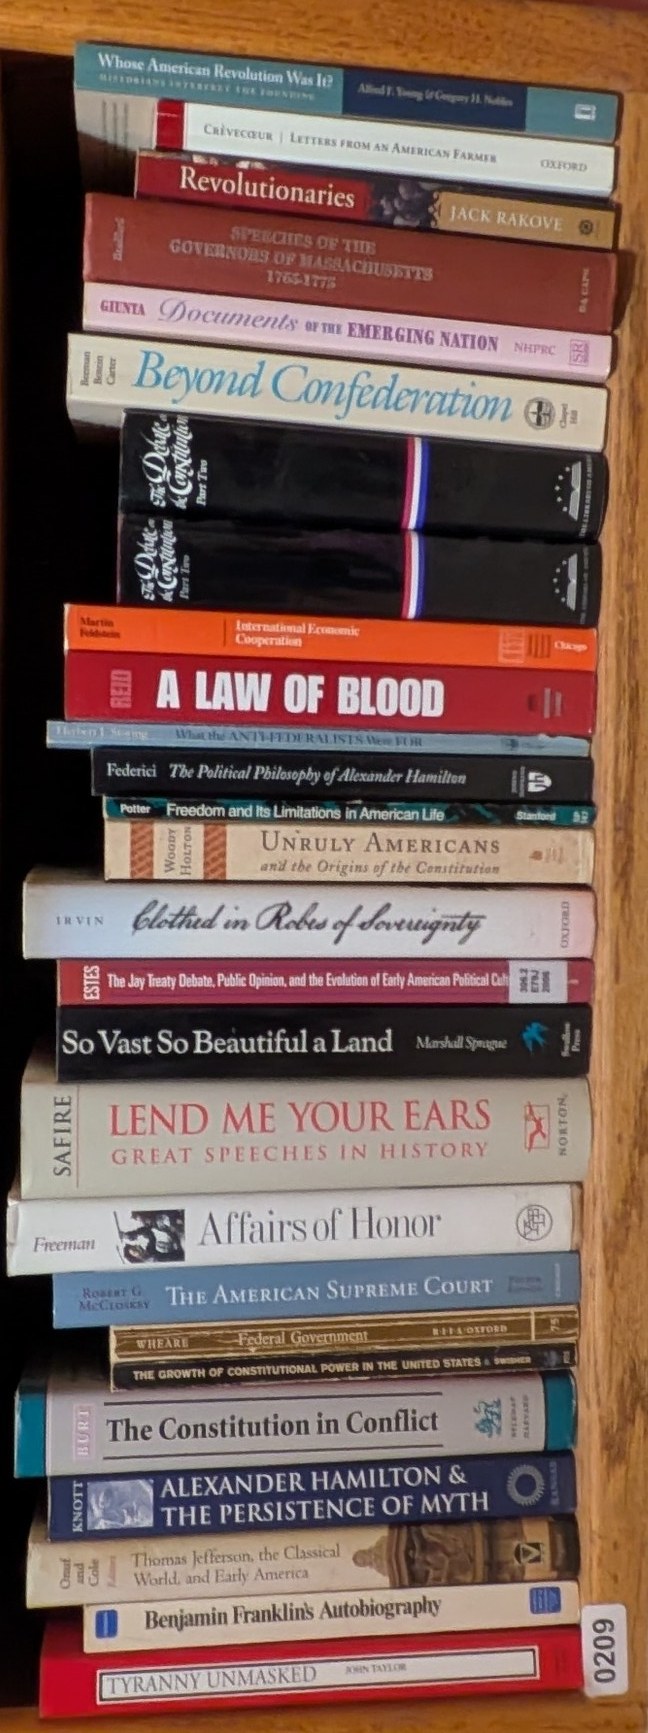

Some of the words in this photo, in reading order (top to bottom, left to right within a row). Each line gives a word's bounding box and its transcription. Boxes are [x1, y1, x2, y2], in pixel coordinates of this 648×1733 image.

[98, 52, 145, 72] Whose
[149, 58, 210, 78] American
[214, 64, 284, 84] Revolution
[286, 70, 314, 87] Was
[316, 73, 334, 89] It?
[290, 131, 337, 148] LETTERS
[340, 138, 371, 151] FROM
[373, 141, 390, 152] AN
[391, 142, 451, 160] AMERICAN
[453, 148, 497, 164] FARMER
[540, 158, 588, 173] OXFORD
[180, 165, 355, 208] Revolutionaries
[450, 204, 491, 223] JACK
[496, 211, 563, 232] RAKOVE
[231, 226, 313, 249] SPEECHES
[317, 234, 338, 251] OF
[342, 238, 376, 256] THE
[169, 239, 270, 265] GOVERNORS
[273, 252, 296, 267] OF
[299, 254, 434, 282] MASSACHUSETTS
[100, 299, 146, 317] GIUNTA
[158, 297, 299, 333] Documents
[304, 321, 319, 333] OF
[321, 322, 343, 336] THE
[347, 322, 435, 347] EMERGING
[439, 331, 499, 352] NATION
[514, 341, 556, 357] NHPRC
[106, 356, 117, 386] Carter
[131, 348, 268, 405] Beyond
[270, 361, 514, 422] Confederation
[235, 619, 306, 634] International
[307, 623, 361, 637] Economic
[235, 633, 303, 648] Cooperation
[156, 669, 180, 710] A
[195, 670, 273, 712] LAW
[283, 674, 325, 714] OF
[337, 676, 445, 717] BLOOD
[106, 761, 157, 778] Federici
[169, 763, 195, 778] The
[196, 763, 251, 780] Political
[252, 764, 322, 786] Philosophy
[322, 768, 340, 787] of
[337, 766, 404, 784] Alexander
[404, 768, 467, 785] Hamilton
[120, 804, 151, 815] Potter
[166, 803, 226, 819] Freedom
[228, 804, 252, 818] and
[255, 804, 271, 819] Its
[273, 805, 341, 820] Limitations
[345, 807, 357, 820] in
[359, 807, 420, 822] American
[422, 807, 445, 822] Life
[163, 828, 177, 873] WOODY
[180, 826, 193, 876] HOLTON
[260, 830, 356, 852] UNRULY
[364, 832, 500, 854] AMERICANS
[260, 860, 288, 873] and
[291, 860, 313, 873] the
[317, 860, 369, 877] Origins
[373, 861, 388, 876] of
[390, 861, 411, 875] the
[416, 861, 500, 876] Constitution
[56, 915, 105, 925] IRVIN
[131, 899, 225, 937] Clothed
[224, 906, 250, 931] in
[254, 901, 327, 932] Robes
[332, 904, 364, 946] of
[358, 902, 487, 946] Sovereignty
[83, 965, 101, 1001] ESTES
[107, 974, 126, 989] The
[127, 974, 146, 990] Jay
[148, 974, 177, 991] Treaty
[178, 974, 216, 989] Debate,
[217, 973, 247, 988] Public
[248, 973, 288, 990] Opinion,
[289, 973, 308, 988] and
[308, 973, 325, 987] the
[325, 972, 370, 988] Evolution
[370, 972, 381, 987] of
[382, 972, 405, 991] Early
[406, 972, 451, 987] American
[452, 972, 490, 987] Political
[61, 1029, 96, 1055] So
[97, 1029, 153, 1055] Vast
[156, 1029, 189, 1055] So
[191, 1027, 309, 1055] Beautiful
[313, 1036, 328, 1054] a
[331, 1027, 394, 1054] Land
[416, 1035, 465, 1050] Marshall
[466, 1035, 508, 1052] Sprague
[108, 1102, 209, 1137] LEND
[221, 1101, 276, 1134] ME
[287, 1099, 395, 1134] YOUR
[403, 1098, 491, 1132] EARS
[53, 1095, 72, 1177] SAFIRE
[111, 1147, 193, 1166] GREAT
[204, 1144, 328, 1164] SPEECHES
[340, 1143, 367, 1161] IN
[381, 1142, 489, 1160] HISTORY
[196, 1208, 308, 1247] Affairs
[312, 1207, 343, 1242] of
[349, 1206, 442, 1241] Honor
[33, 1236, 96, 1254] Freeman
[165, 1285, 208, 1306] THE
[211, 1283, 320, 1305] AMERICAN
[326, 1279, 419, 1300] SUPREME
[423, 1275, 494, 1296] COURT
[136, 1337, 190, 1350] WHEARE
[237, 1332, 286, 1346] Federal
[290, 1329, 369, 1346] Government
[132, 1369, 155, 1381] THE
[158, 1367, 206, 1380] GROWTH
[208, 1366, 225, 1378] OF
[227, 1363, 318, 1377] CONSTITUTIONAL
[321, 1362, 360, 1374] POWER
[361, 1361, 374, 1372] IN
[377, 1360, 398, 1371] THE
[401, 1358, 441, 1370] UNITED
[443, 1357, 482, 1368] STATES
[76, 1409, 91, 1457] BURT
[106, 1417, 153, 1443] The
[159, 1412, 311, 1442] Constitution
[316, 1411, 340, 1436] in
[345, 1408, 439, 1435] Conflict
[160, 1473, 306, 1499] ALEXANDER
[311, 1464, 442, 1492] HAMILTON
[448, 1463, 469, 1485] &
[71, 1480, 85, 1534] KNOTT
[160, 1505, 212, 1528] THE
[219, 1497, 376, 1525] PERSISTENCE
[381, 1495, 414, 1517] OF
[420, 1491, 490, 1515] MYTH
[131, 1552, 188, 1569] Thomas
[191, 1548, 255, 1568] Jefferson,
[258, 1546, 280, 1562] the
[283, 1543, 341, 1561] Classical
[74, 1562, 86, 1585] and
[88, 1558, 101, 1588] Cole
[134, 1571, 182, 1587] World,
[186, 1570, 210, 1585] and
[214, 1569, 249, 1587] Early
[253, 1566, 310, 1583] America
[144, 1608, 229, 1632] Benjamin
[232, 1602, 315, 1626] Franklin's
[319, 1596, 443, 1621] Autobiography
[592, 1618, 616, 1684] 0209
[106, 1673, 201, 1697] TYRANNY
[206, 1666, 317, 1690] UNMASKED
[345, 1663, 371, 1676] JOHN
[371, 1662, 408, 1675] TAYLOR
